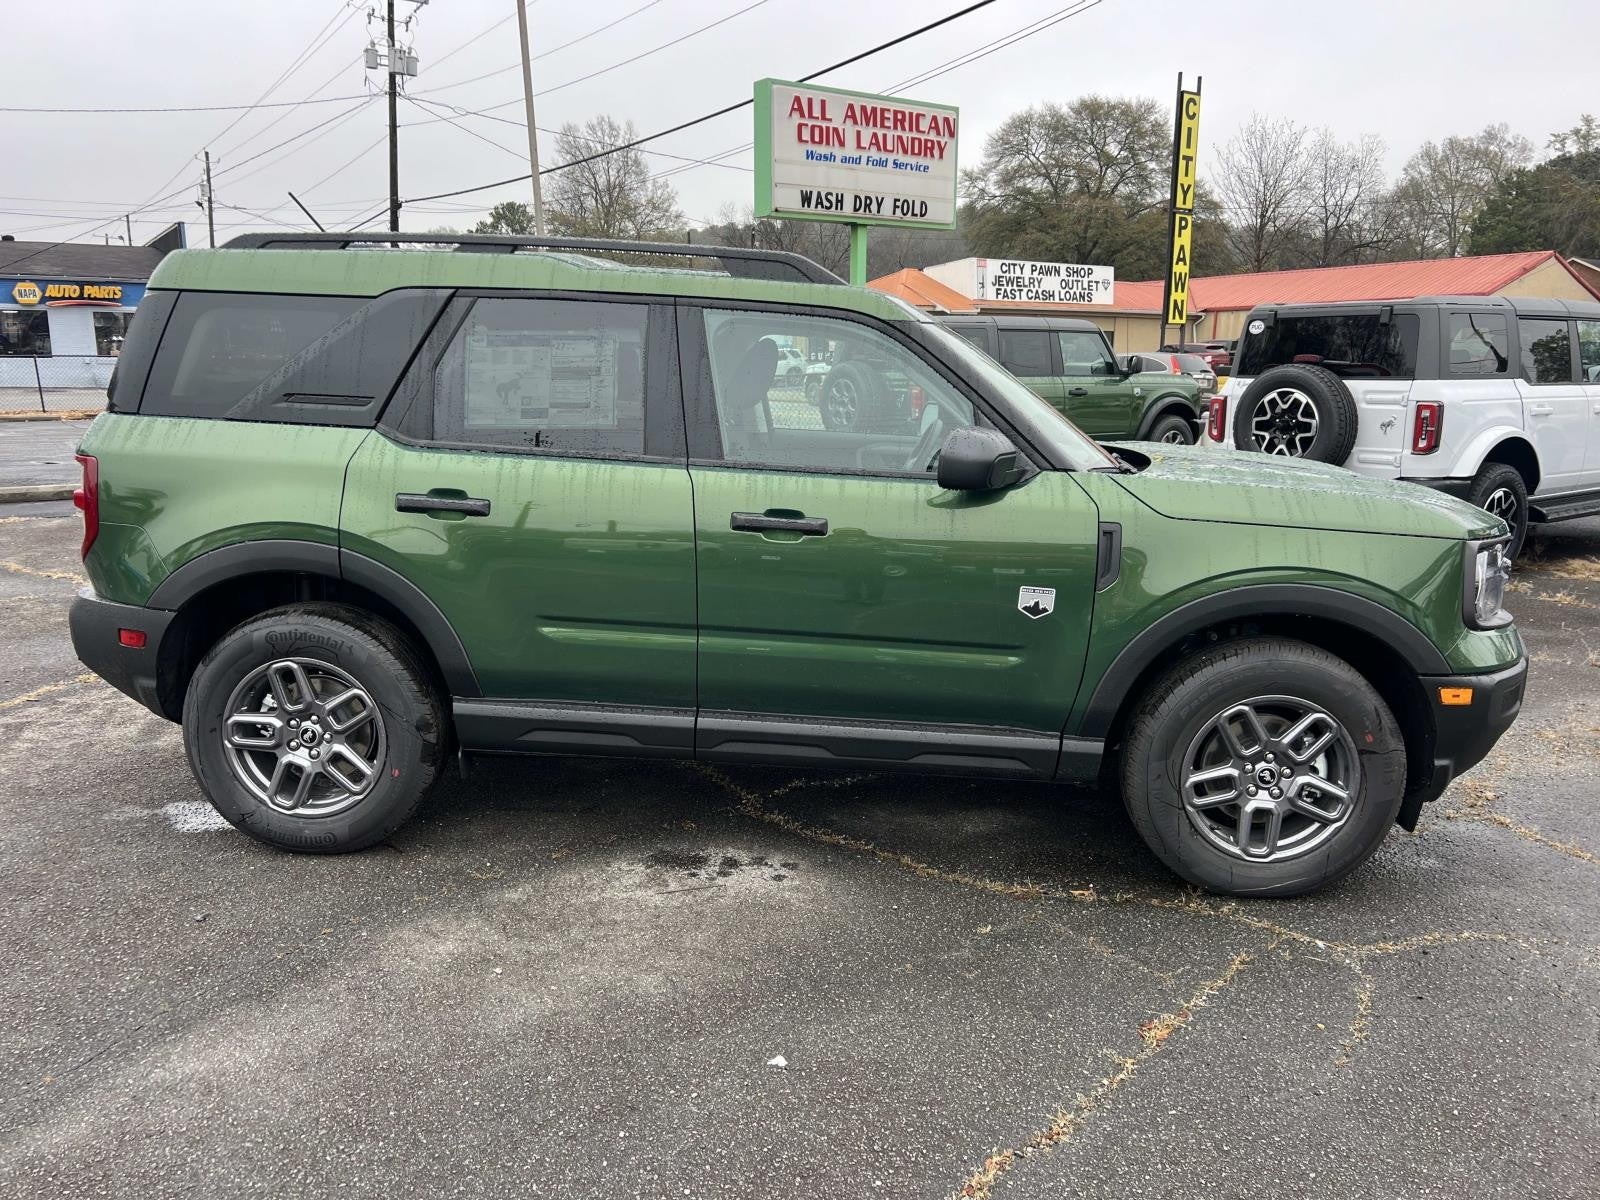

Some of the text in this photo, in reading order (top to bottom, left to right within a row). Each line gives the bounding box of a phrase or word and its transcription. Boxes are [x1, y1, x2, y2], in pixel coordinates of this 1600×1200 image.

[789, 95, 956, 138] ALL AMERICAN
[797, 122, 947, 159] COIN LAUNDRY
[805, 149, 930, 173] Wash and Fold Service
[800, 189, 928, 217] WASH DRY FOLD
[1172, 98, 1198, 321] CITY PAWN
[1000, 263, 1026, 275] CITY
[1030, 264, 1061, 277] PAWN
[1065, 266, 1094, 279] SHOP
[17, 284, 122, 299] NAPA AUTO PARTS
[991, 275, 1100, 291] JEWELRY OUTLET
[996, 288, 1093, 303] FAST CASH LOANS
[264, 629, 345, 650] Continental
